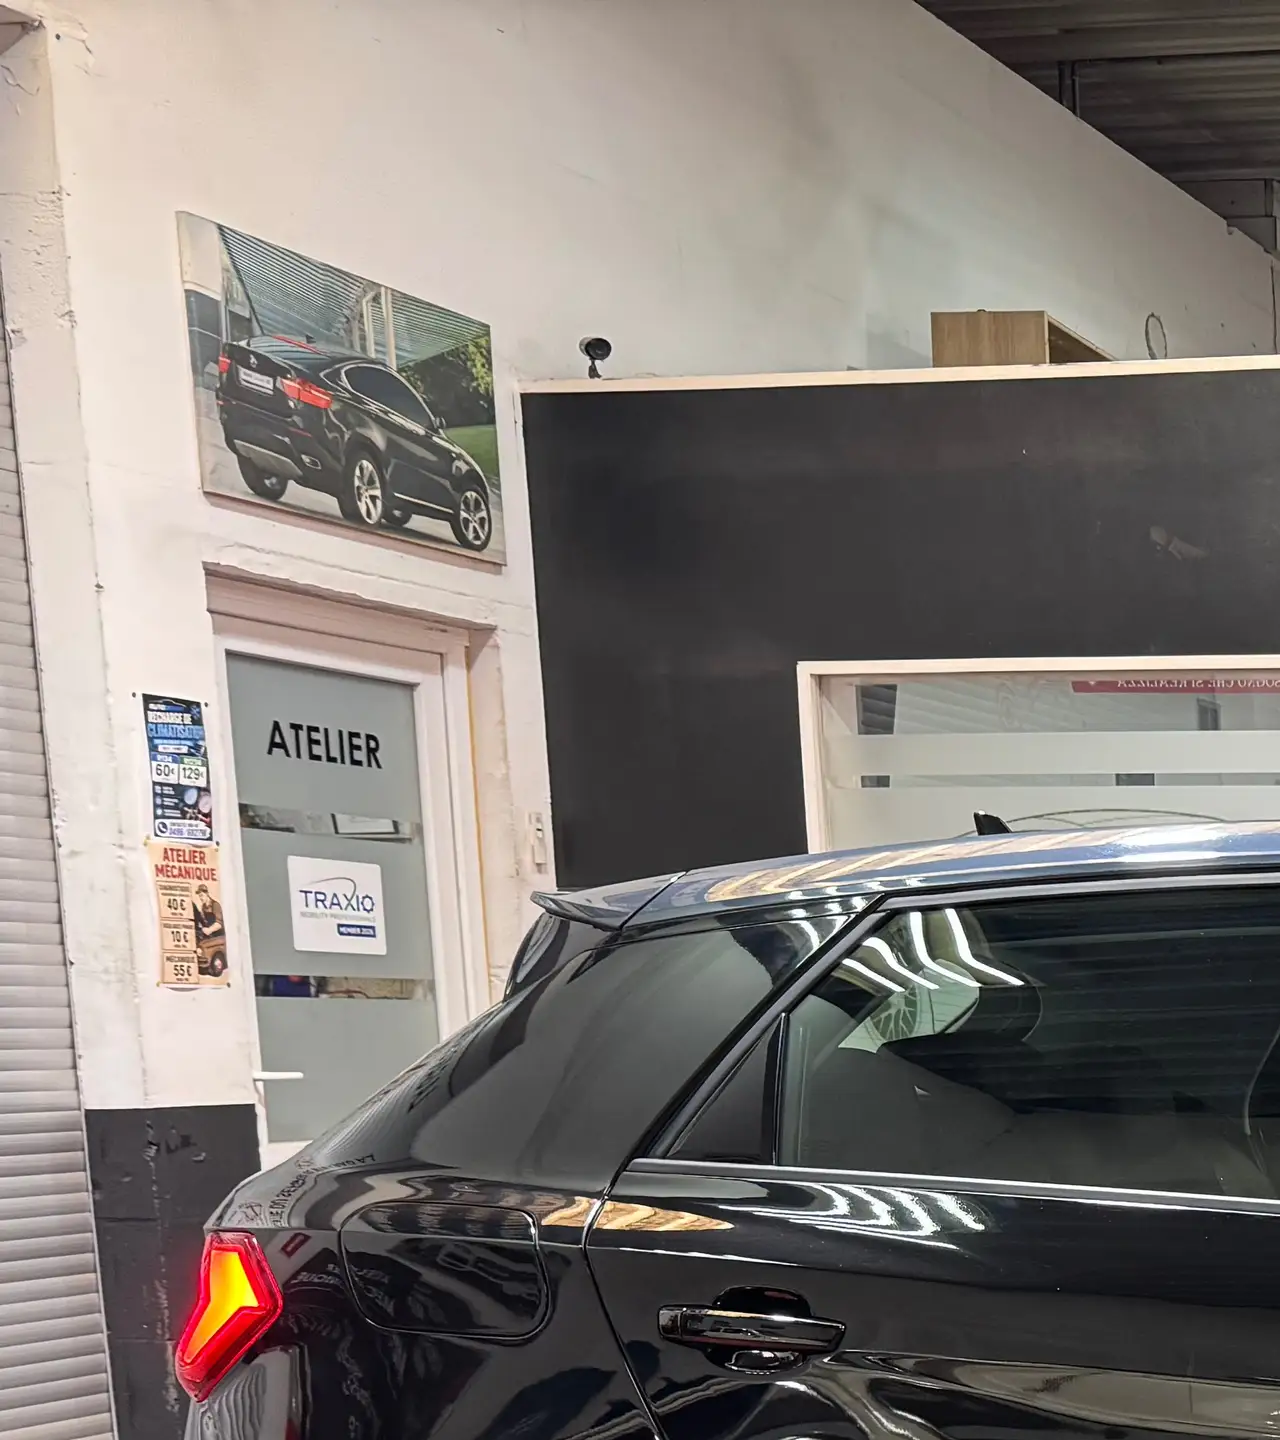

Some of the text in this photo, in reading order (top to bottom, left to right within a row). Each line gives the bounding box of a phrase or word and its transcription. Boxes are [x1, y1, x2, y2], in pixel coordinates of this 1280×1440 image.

[267, 720, 382, 769] ATELIER
[163, 847, 206, 864] ATELIER
[167, 898, 178, 910] 40
[299, 889, 375, 913] TRAXIO
[171, 930, 181, 942] 10
[173, 964, 185, 976] 55
